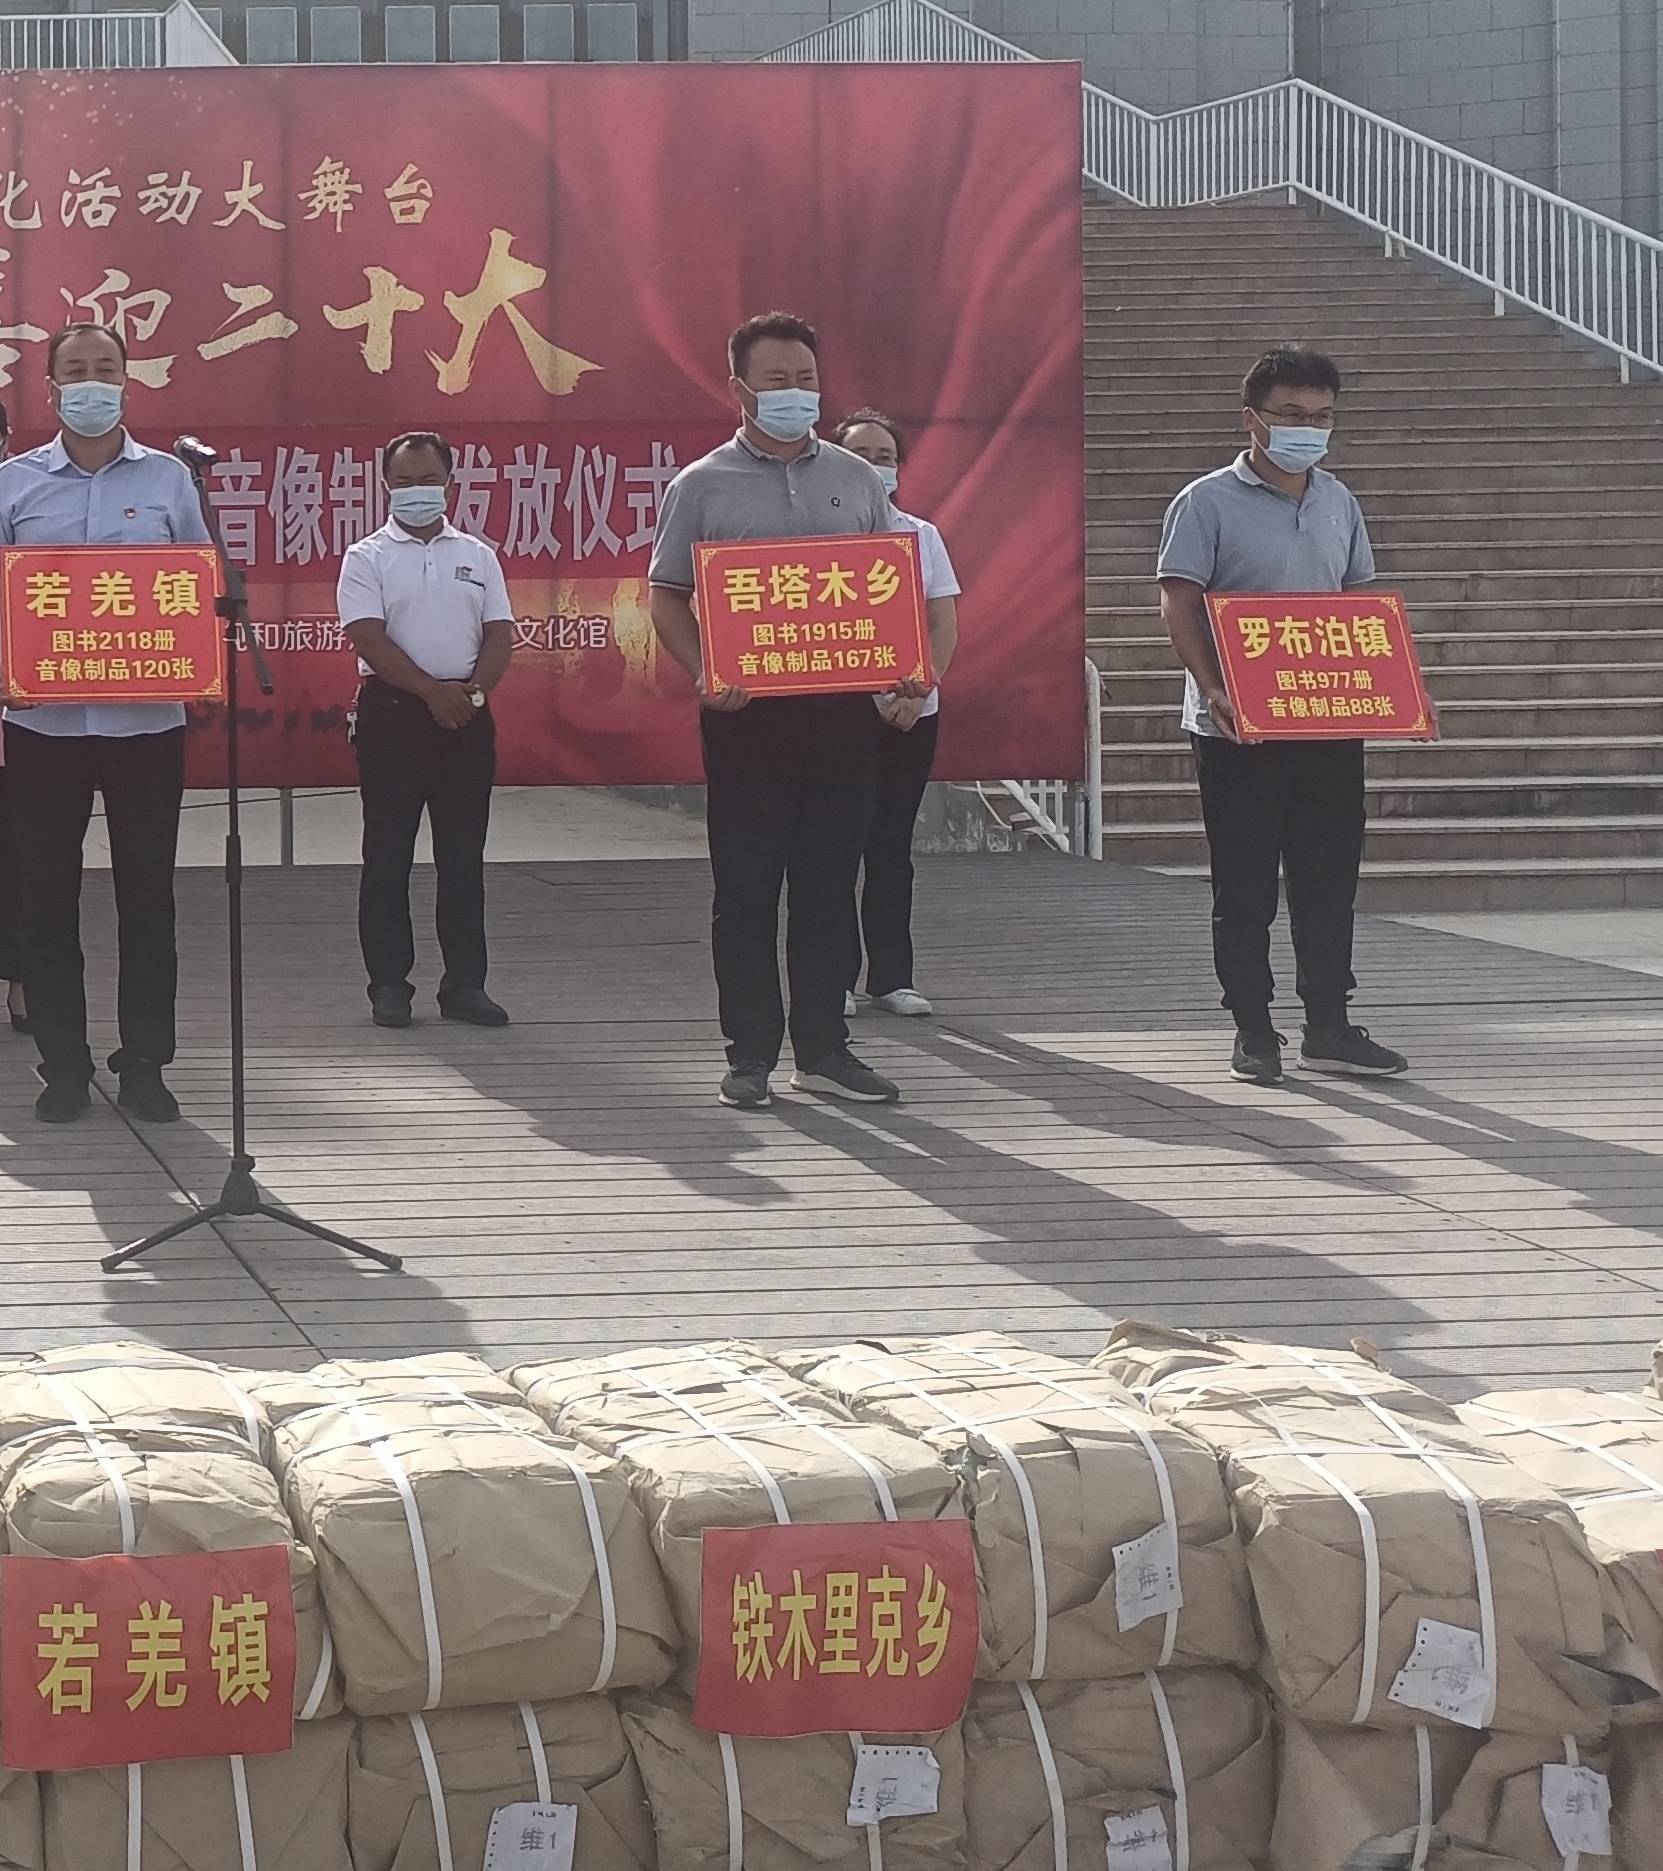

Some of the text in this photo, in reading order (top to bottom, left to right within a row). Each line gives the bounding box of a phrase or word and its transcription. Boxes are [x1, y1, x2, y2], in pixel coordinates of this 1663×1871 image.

[25, 570, 201, 619] 若羌镇
[723, 558, 901, 613] 吾塔木乡
[52, 629, 177, 653] 图书2118册
[752, 618, 877, 647] 图书1915册
[1237, 615, 1394, 659] 罗布泊镇
[35, 657, 196, 682] 音像制品120张
[738, 645, 897, 676] 音像制品167张
[1275, 669, 1373, 691] 图书977册
[1267, 696, 1396, 718] 音像制品88张
[732, 1563, 952, 1684] 铁木里克乡
[37, 1592, 272, 1715] 若羌镇
[519, 1825, 557, 1852] 维1
